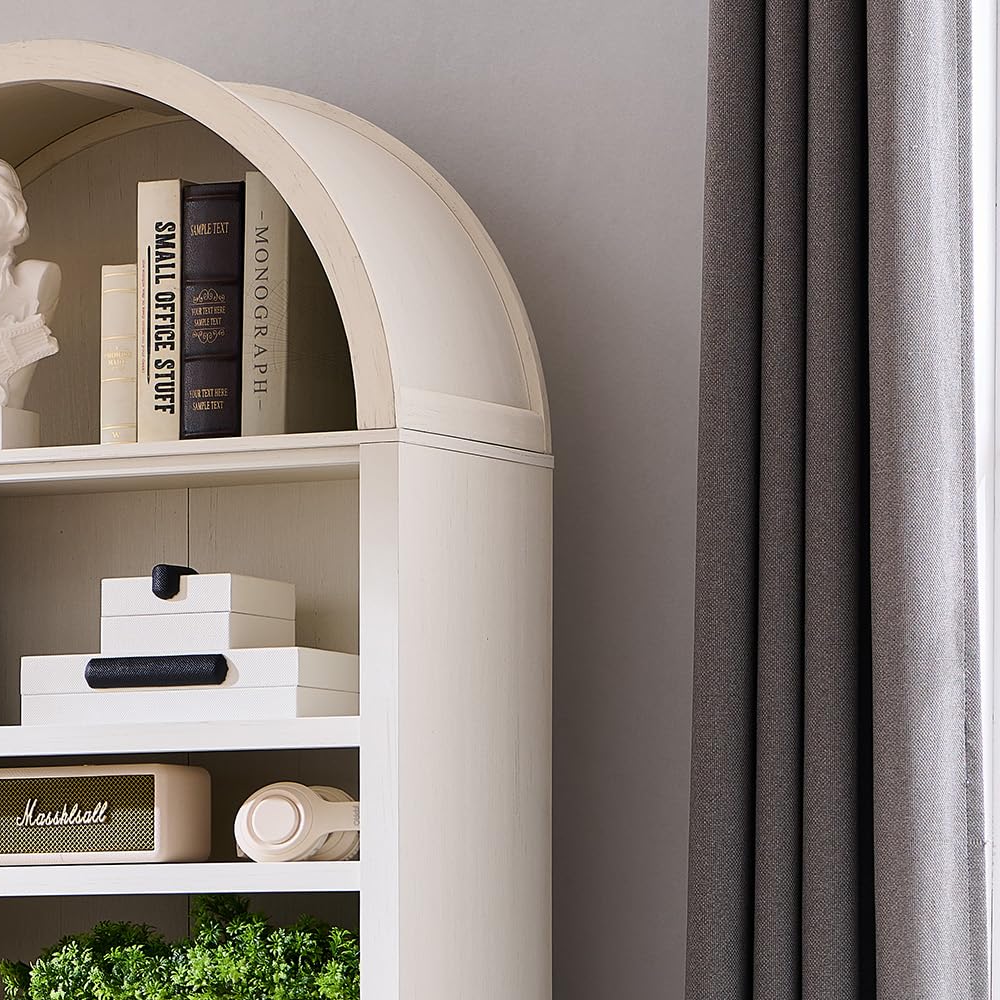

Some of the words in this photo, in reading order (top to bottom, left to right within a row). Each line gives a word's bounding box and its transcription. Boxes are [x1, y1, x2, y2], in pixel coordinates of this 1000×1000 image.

[190, 223, 211, 237] SAMPLE
[212, 222, 229, 235] TEXT
[154, 221, 177, 285] SMALL
[202, 306, 213, 315] TEXT
[253, 225, 269, 394] MONOGRAPH
[154, 291, 176, 352] OFFICE
[194, 318, 210, 327] SAMPLE
[210, 317, 222, 325] TEXT
[154, 358, 175, 415] STUFF
[201, 388, 213, 398] TEXT
[192, 401, 210, 410] SAMPLE
[210, 400, 224, 410] TEXT
